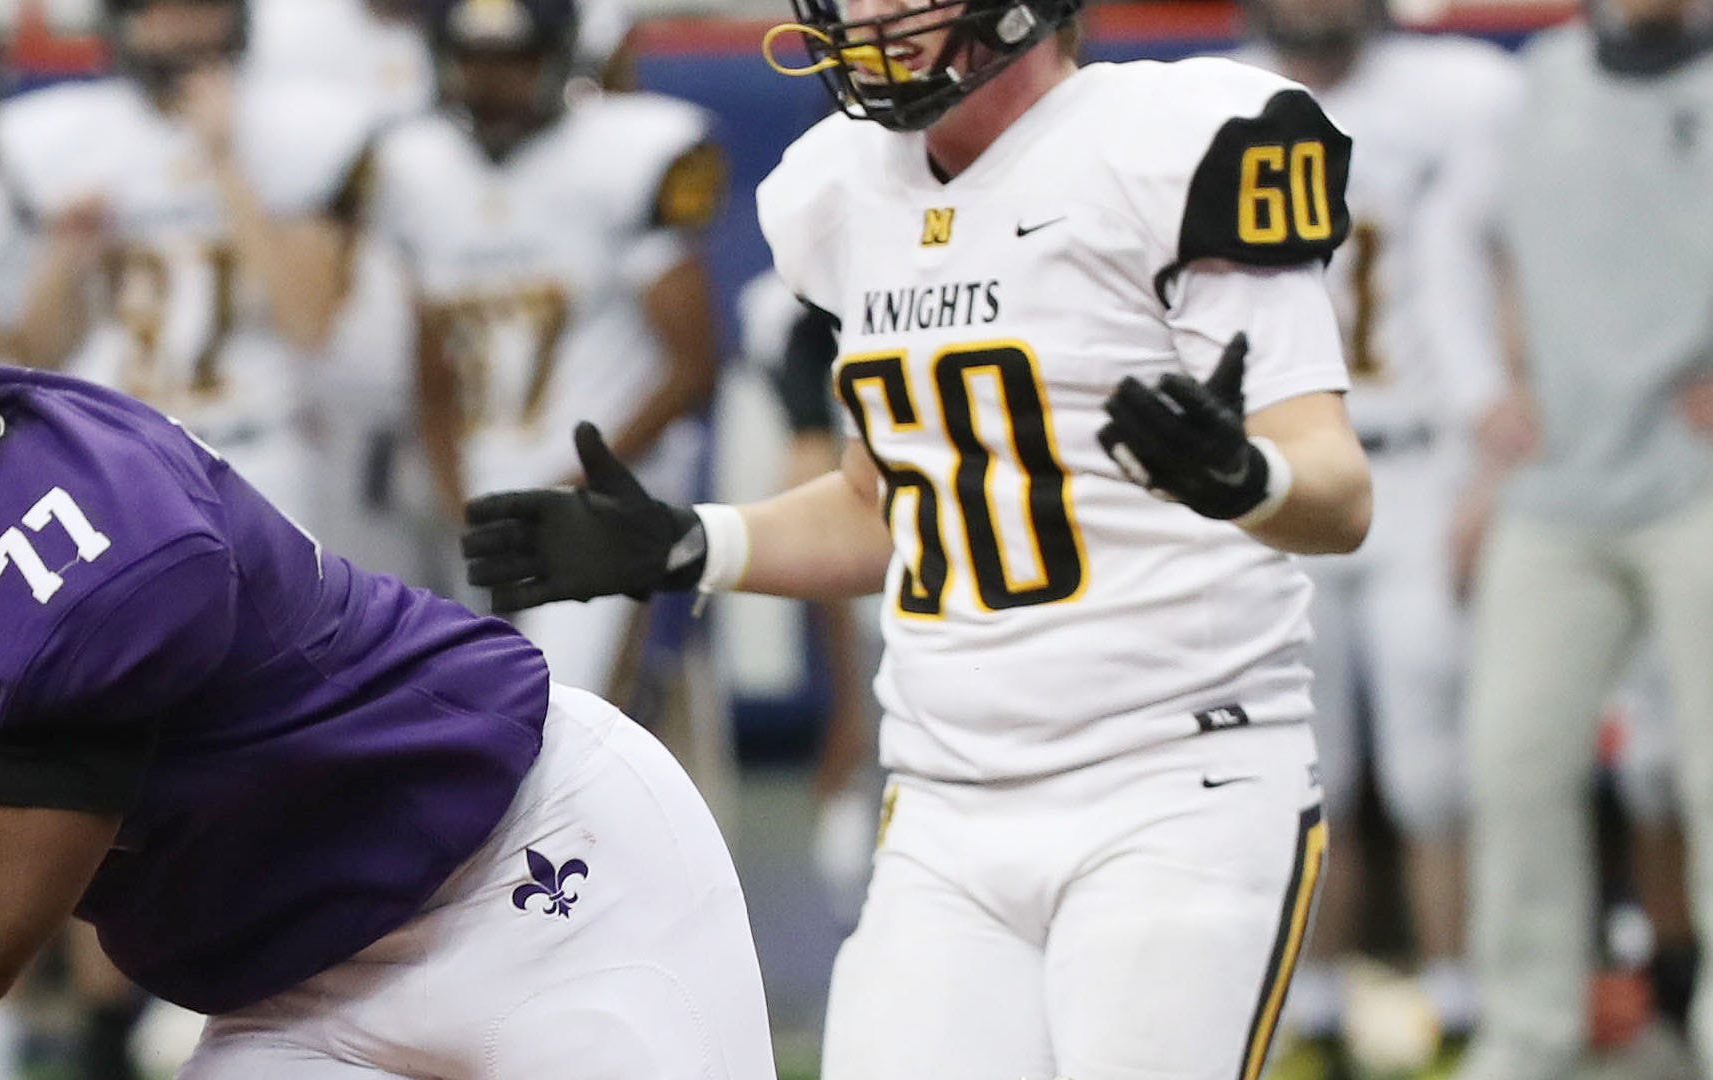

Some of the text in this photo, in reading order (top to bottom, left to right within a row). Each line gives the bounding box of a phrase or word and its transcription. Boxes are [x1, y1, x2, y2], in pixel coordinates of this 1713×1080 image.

[1238, 140, 1332, 244] 60
[861, 279, 1000, 336] KNIGHTS
[832, 337, 1092, 621] 60
